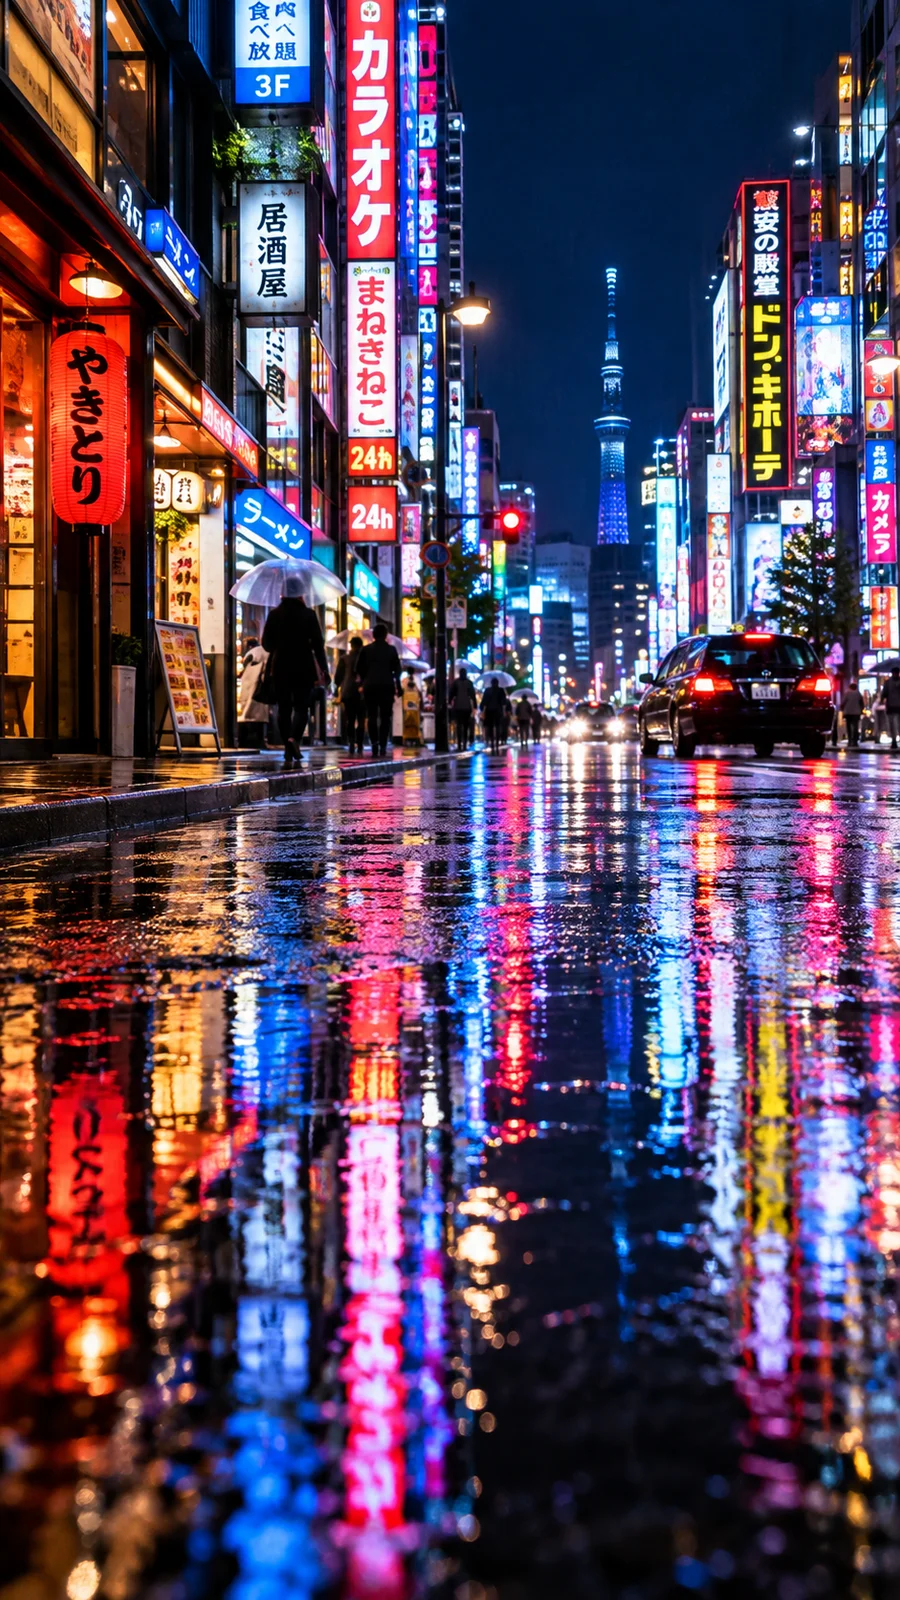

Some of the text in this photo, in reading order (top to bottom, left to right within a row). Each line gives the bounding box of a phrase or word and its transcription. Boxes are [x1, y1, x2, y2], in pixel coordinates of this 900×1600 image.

[255, 73, 290, 98] 3F
[350, 29, 391, 248] カラオケ
[256, 202, 288, 298] 居酒屋
[356, 276, 387, 426] まねきねこ
[752, 304, 782, 481] ドン・キホーテ
[67, 345, 108, 505] やきとり
[243, 497, 304, 550] ラーメン
[351, 503, 393, 529] 24h
[872, 490, 891, 555] カメラ
